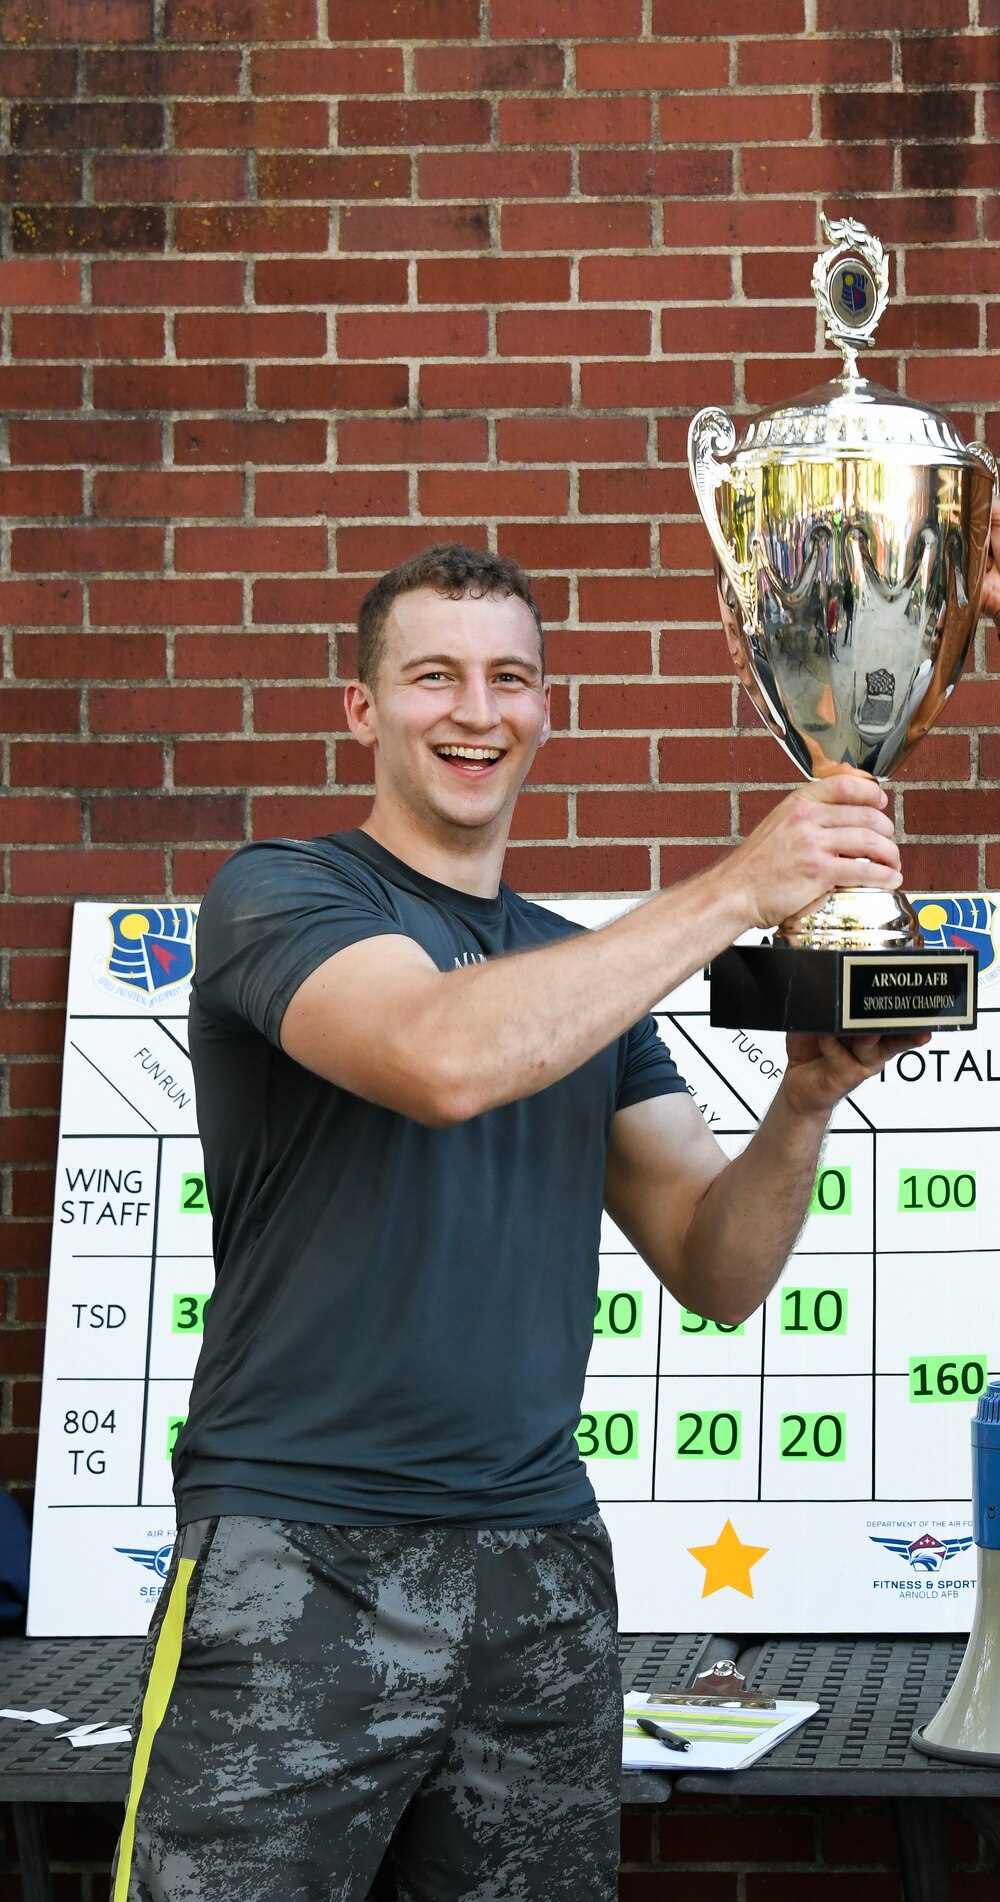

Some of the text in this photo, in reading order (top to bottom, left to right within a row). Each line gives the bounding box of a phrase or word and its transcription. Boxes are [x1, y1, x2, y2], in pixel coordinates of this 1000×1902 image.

[872, 972, 948, 987] ARNOLD AFB
[864, 995, 954, 1010] SPORTS DAY CHAMPION
[732, 1029, 783, 1079] TUG OF
[134, 1047, 191, 1109] FUN RUN
[65, 1168, 143, 1194] WING
[903, 1174, 976, 1209] 100
[60, 1200, 150, 1226] STAFF
[72, 1304, 126, 1329] TSD
[177, 1297, 209, 1329] 3
[784, 1290, 842, 1332] 10
[913, 1362, 984, 1396] 160
[63, 1409, 116, 1434] 804
[578, 1412, 634, 1456] 30
[677, 1413, 738, 1455] 20
[781, 1414, 842, 1458] 20
[68, 1450, 106, 1475] TG
[873, 1580, 977, 1589] FITNESS & SPORT
[899, 1590, 959, 1599] ARNOLD AFB
